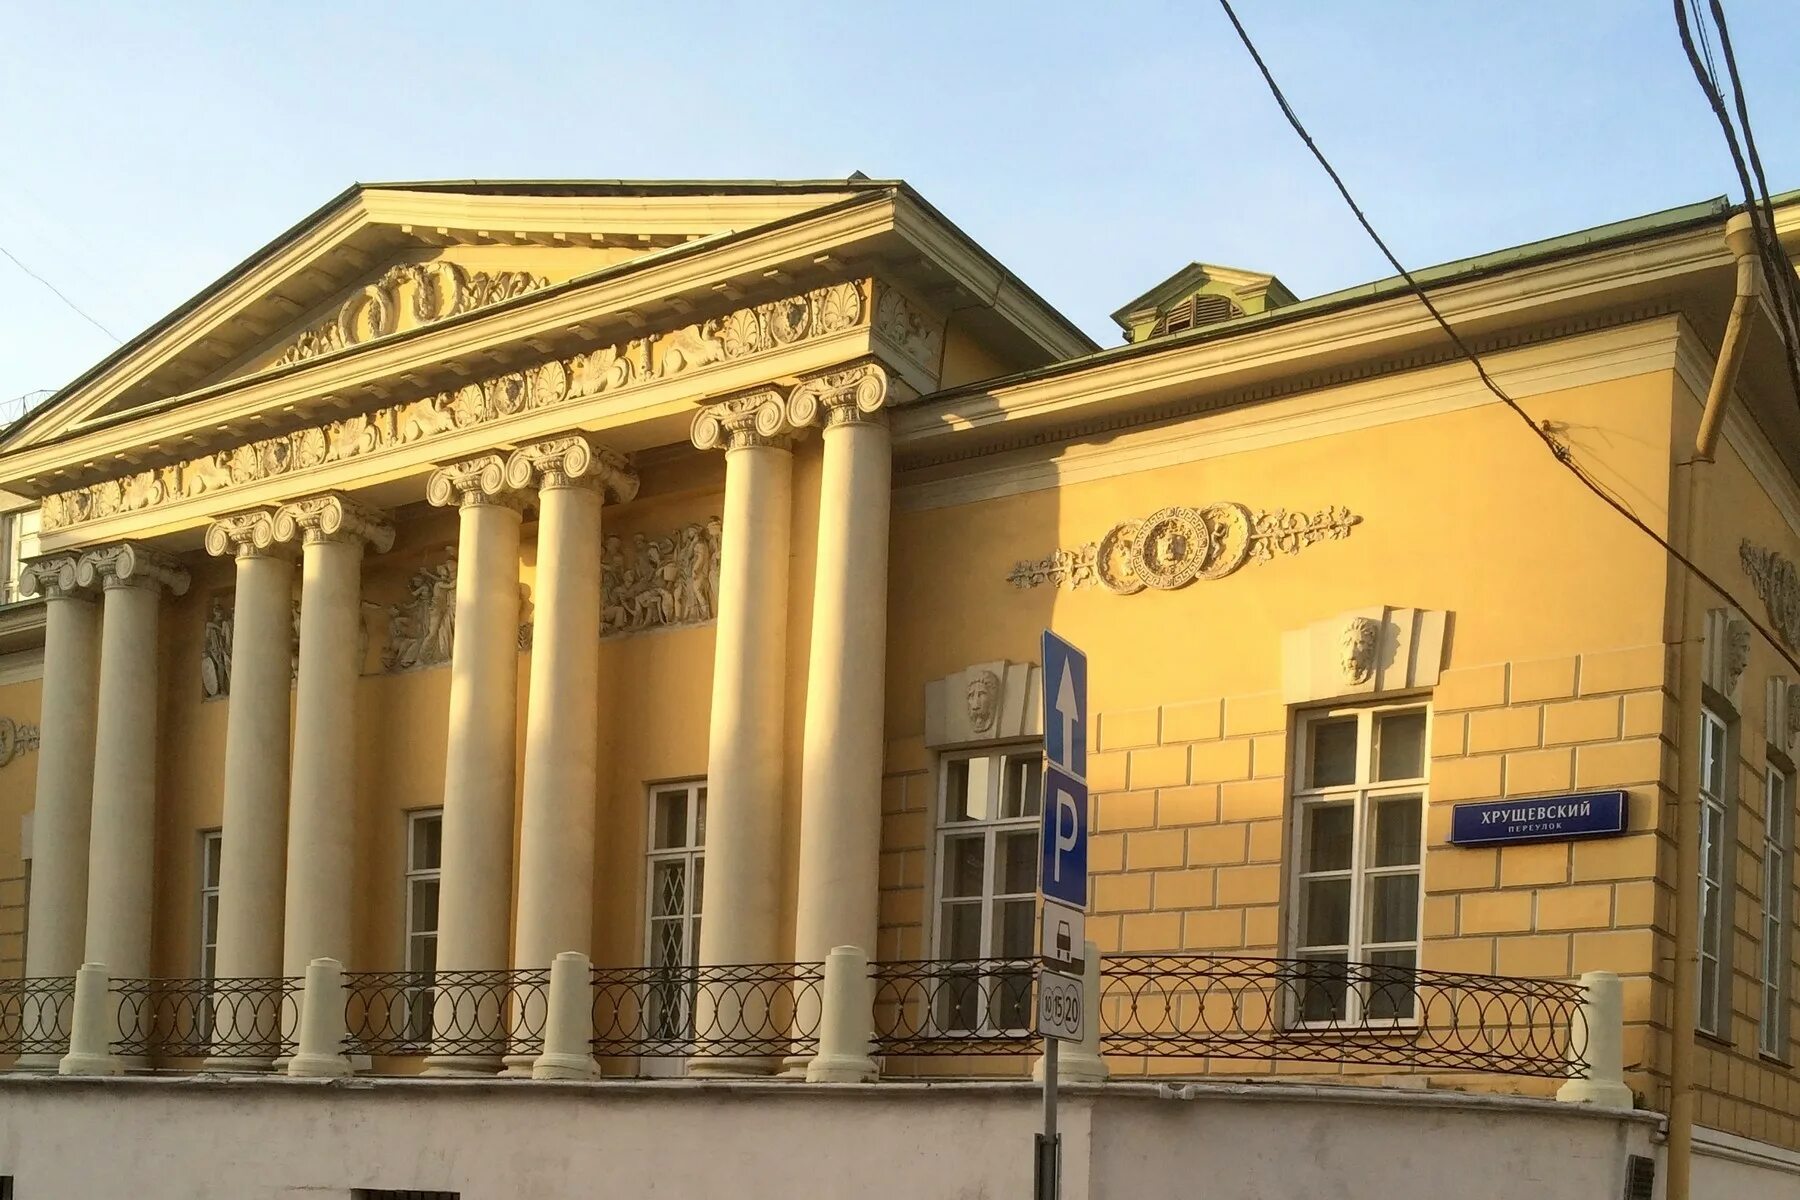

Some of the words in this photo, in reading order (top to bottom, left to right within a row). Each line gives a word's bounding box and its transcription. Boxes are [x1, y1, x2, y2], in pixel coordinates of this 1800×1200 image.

[1481, 800, 1591, 824] ХРУЩЕВСКИЙ
[1054, 788, 1078, 882] P
[1508, 822, 1562, 833] ПЕРЕУЛОК
[1054, 995, 1062, 1018] 15
[1065, 996, 1079, 1022] 20
